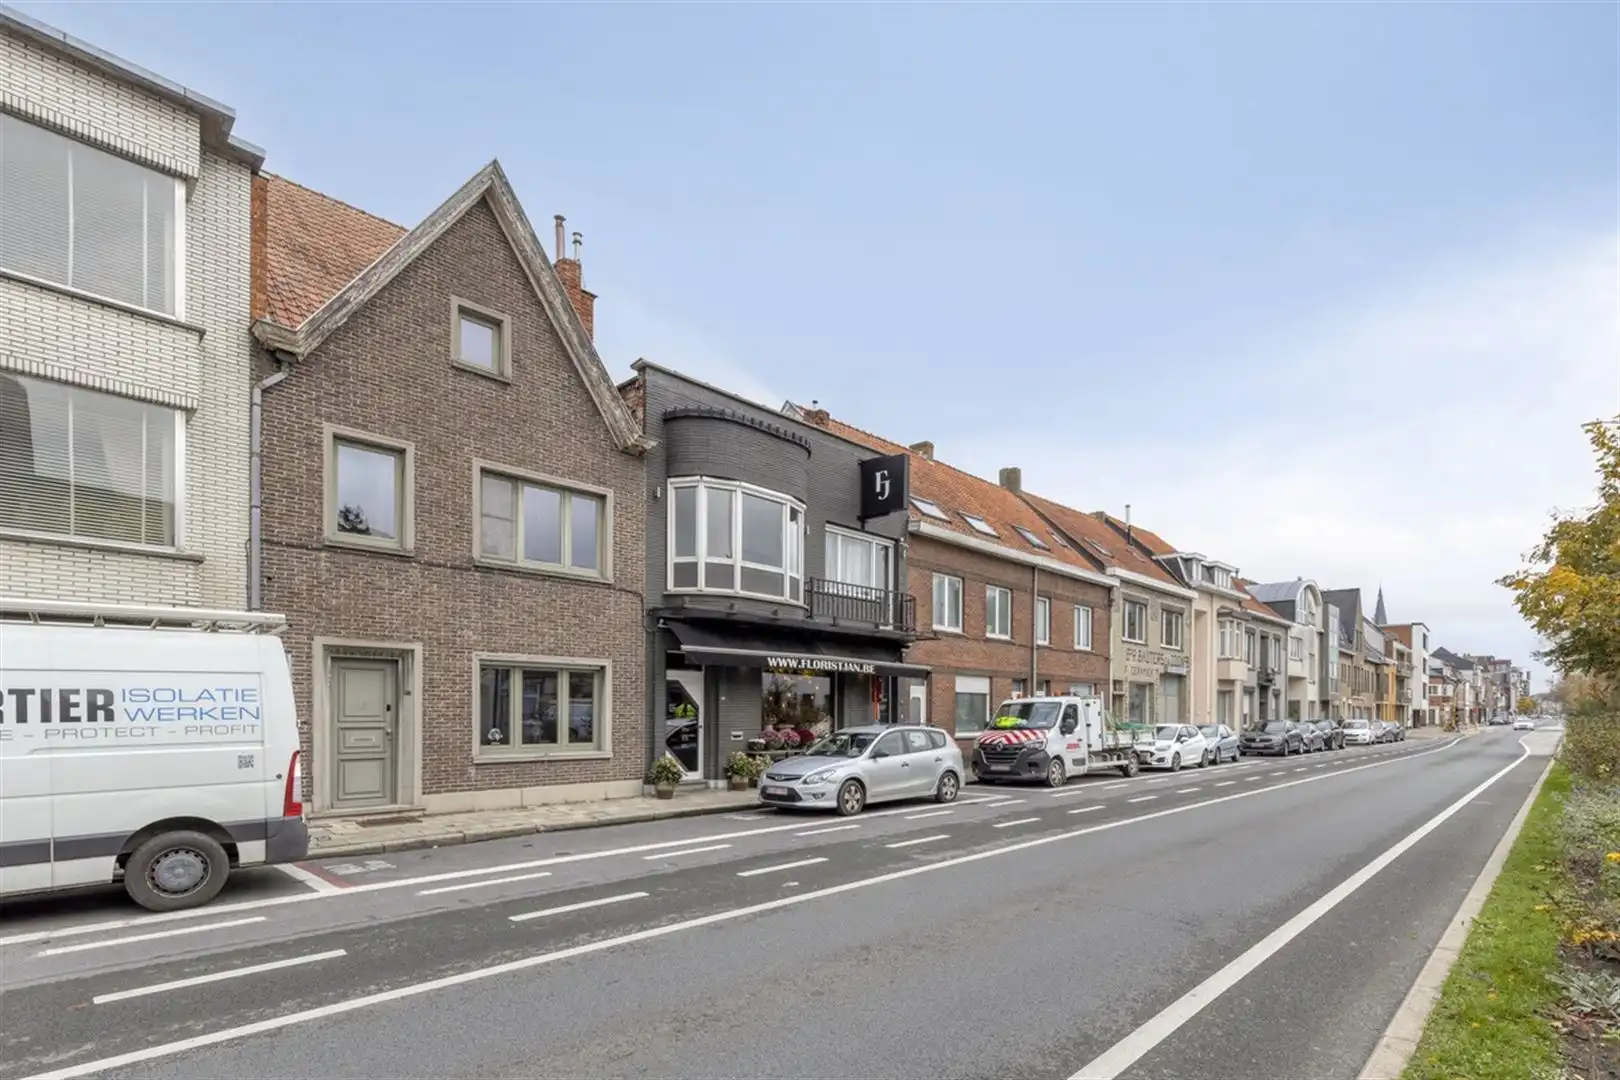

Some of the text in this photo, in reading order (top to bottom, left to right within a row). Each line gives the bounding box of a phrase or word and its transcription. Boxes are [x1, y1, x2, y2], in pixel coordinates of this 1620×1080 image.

[122, 688, 257, 702] ISOLATIE
[124, 706, 260, 722] WERKEN
[45, 726, 160, 740] PROTECT
[184, 724, 260, 736] PROFIT
